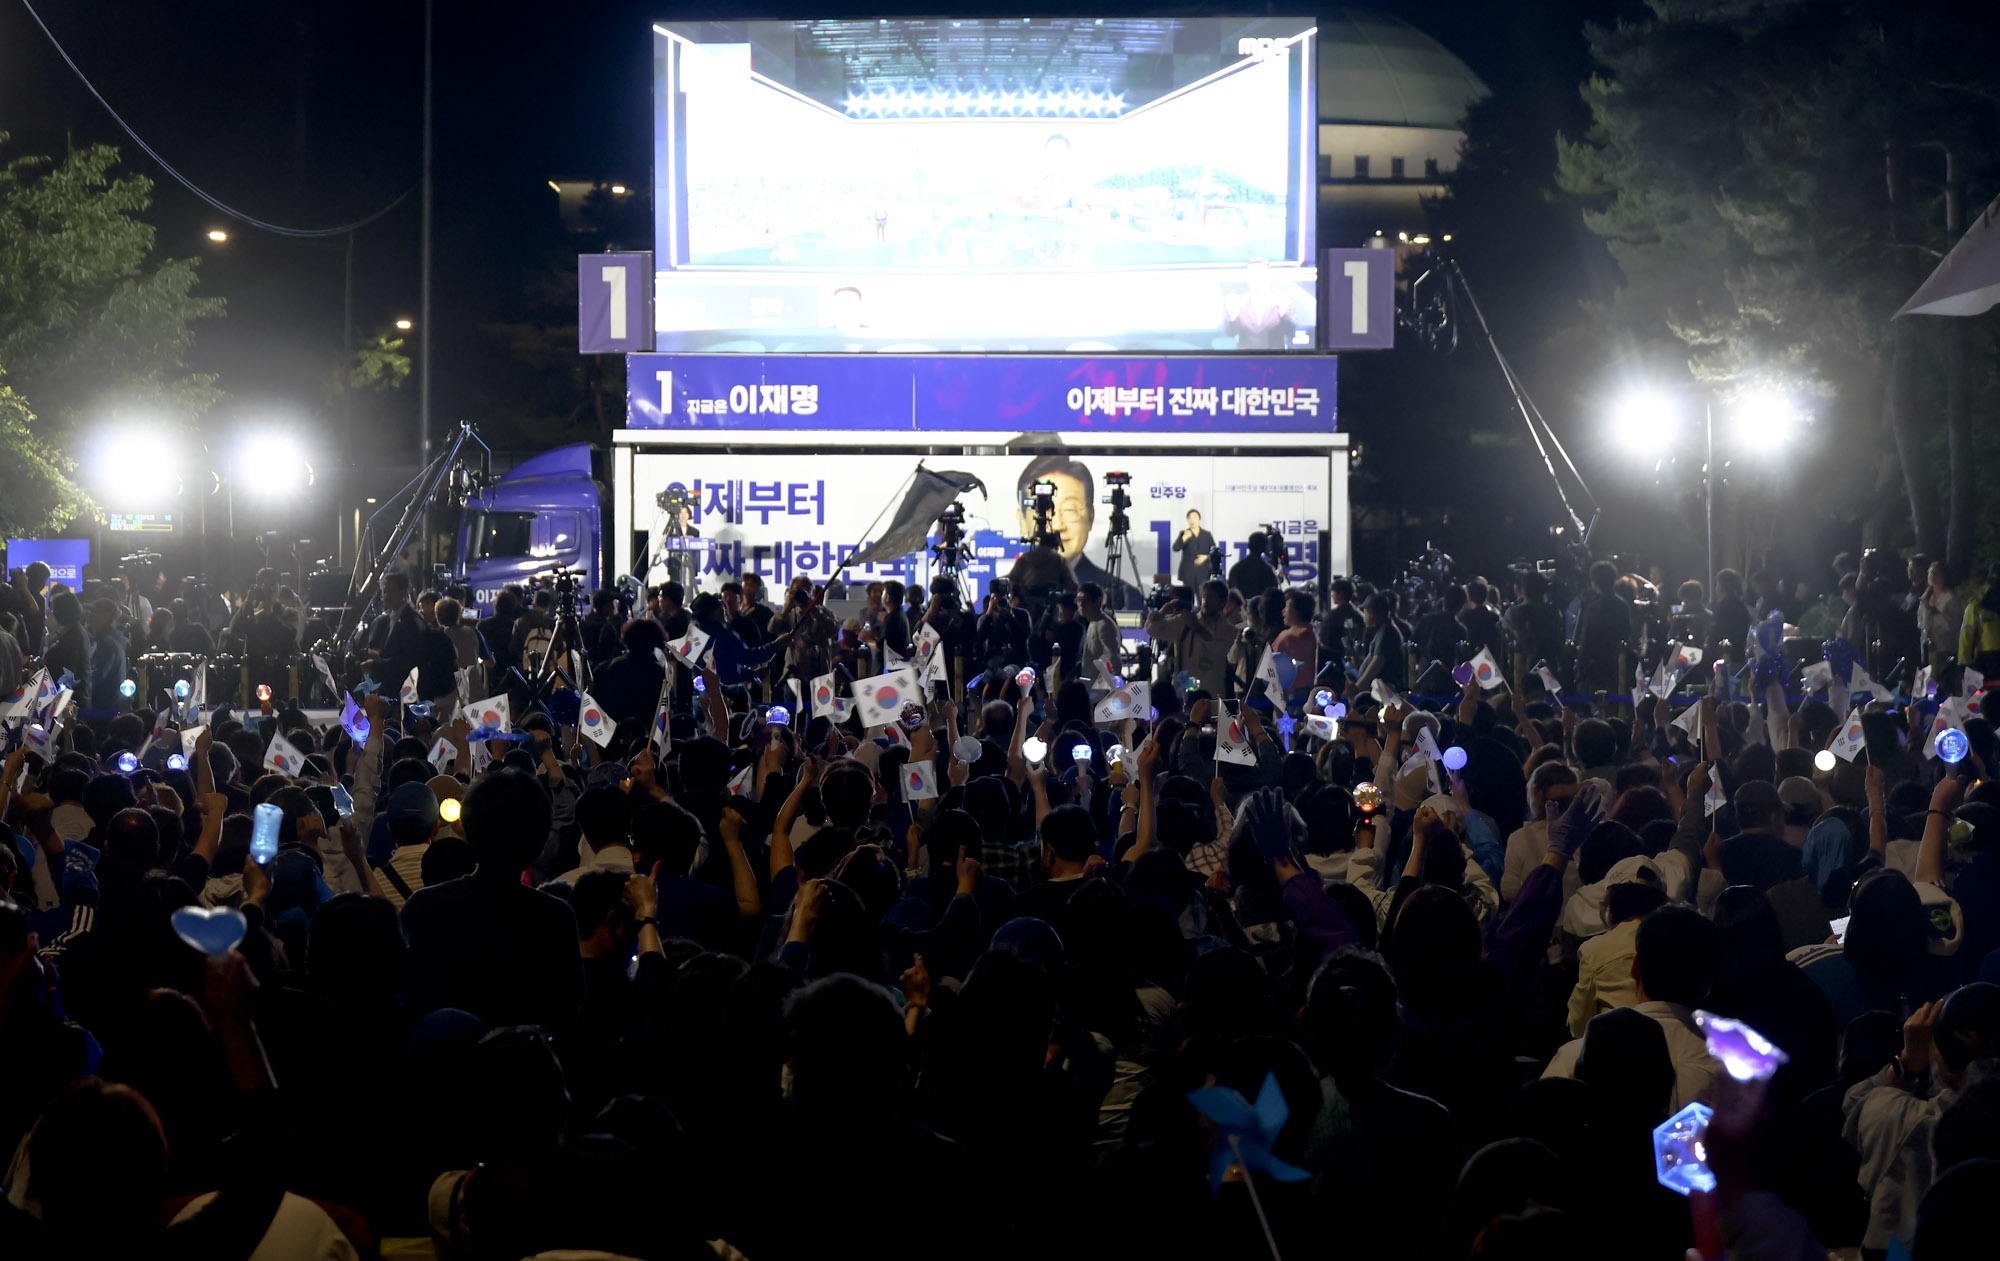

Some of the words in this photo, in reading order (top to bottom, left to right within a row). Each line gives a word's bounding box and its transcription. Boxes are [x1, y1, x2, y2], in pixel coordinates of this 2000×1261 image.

[603, 267, 626, 339] 1
[1345, 262, 1368, 334] 1
[656, 371, 673, 414] 1
[687, 398, 728, 415] 지금은
[730, 384, 819, 415] 이재명
[1067, 386, 1163, 416] 이제부터
[1168, 386, 1218, 416] 진짜
[1221, 386, 1320, 417] 대한민국
[666, 479, 824, 525] 이제부터
[1150, 486, 1187, 499] 민주당
[1273, 519, 1318, 535] 지금은
